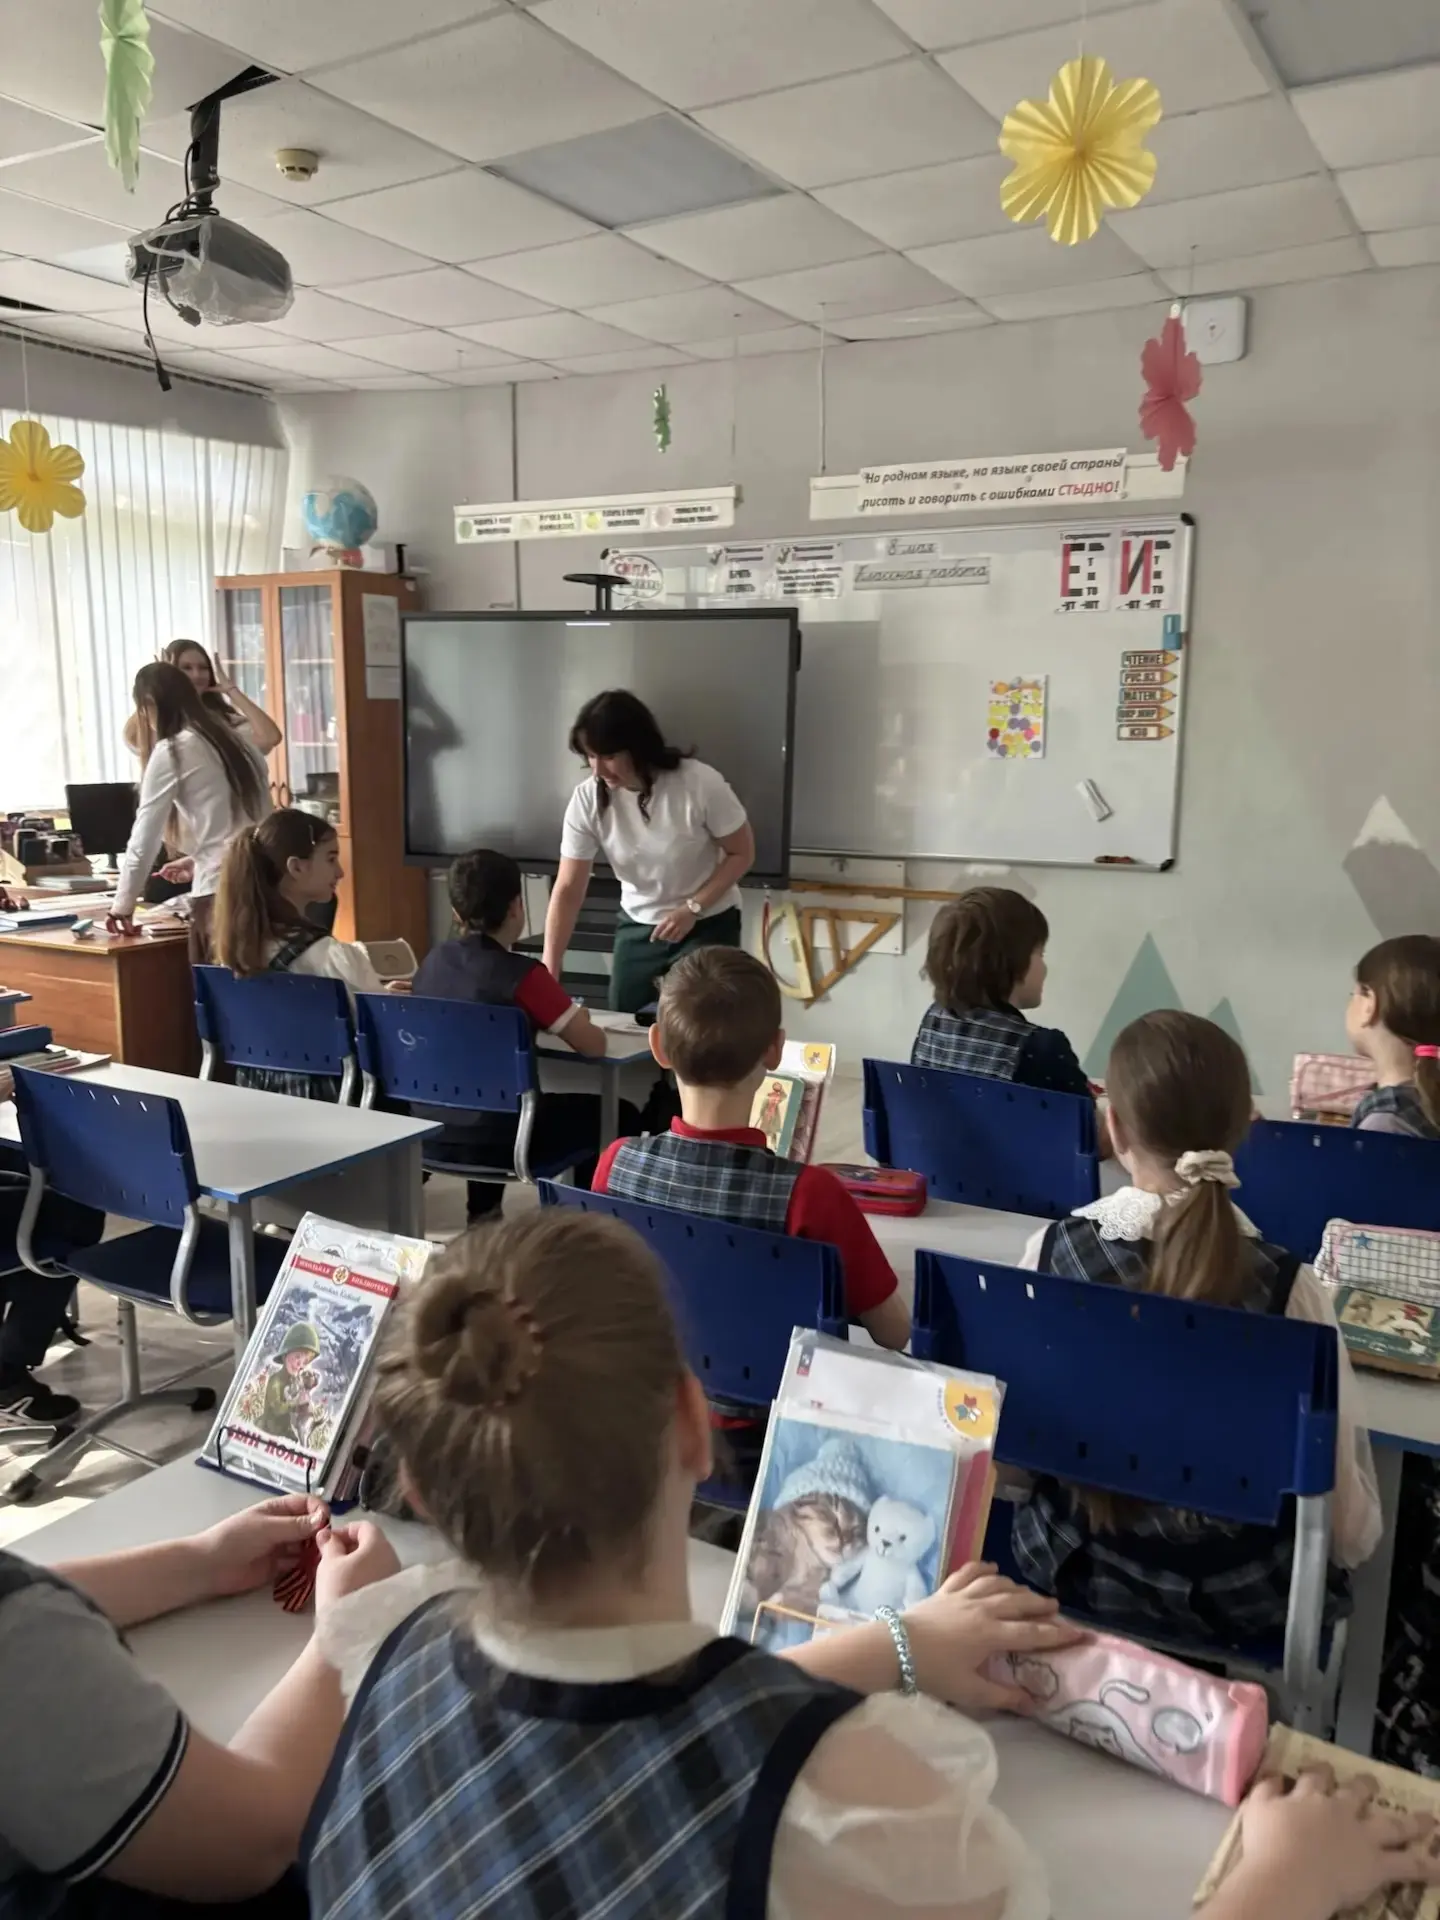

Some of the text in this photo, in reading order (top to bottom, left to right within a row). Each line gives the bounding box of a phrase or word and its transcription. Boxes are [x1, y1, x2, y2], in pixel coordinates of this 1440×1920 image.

[865, 457, 1123, 485] На родном языке, на языке своей страны
[862, 480, 1120, 508] писать и говорить с ошибками СТЫДНО!
[1119, 539, 1153, 595] И
